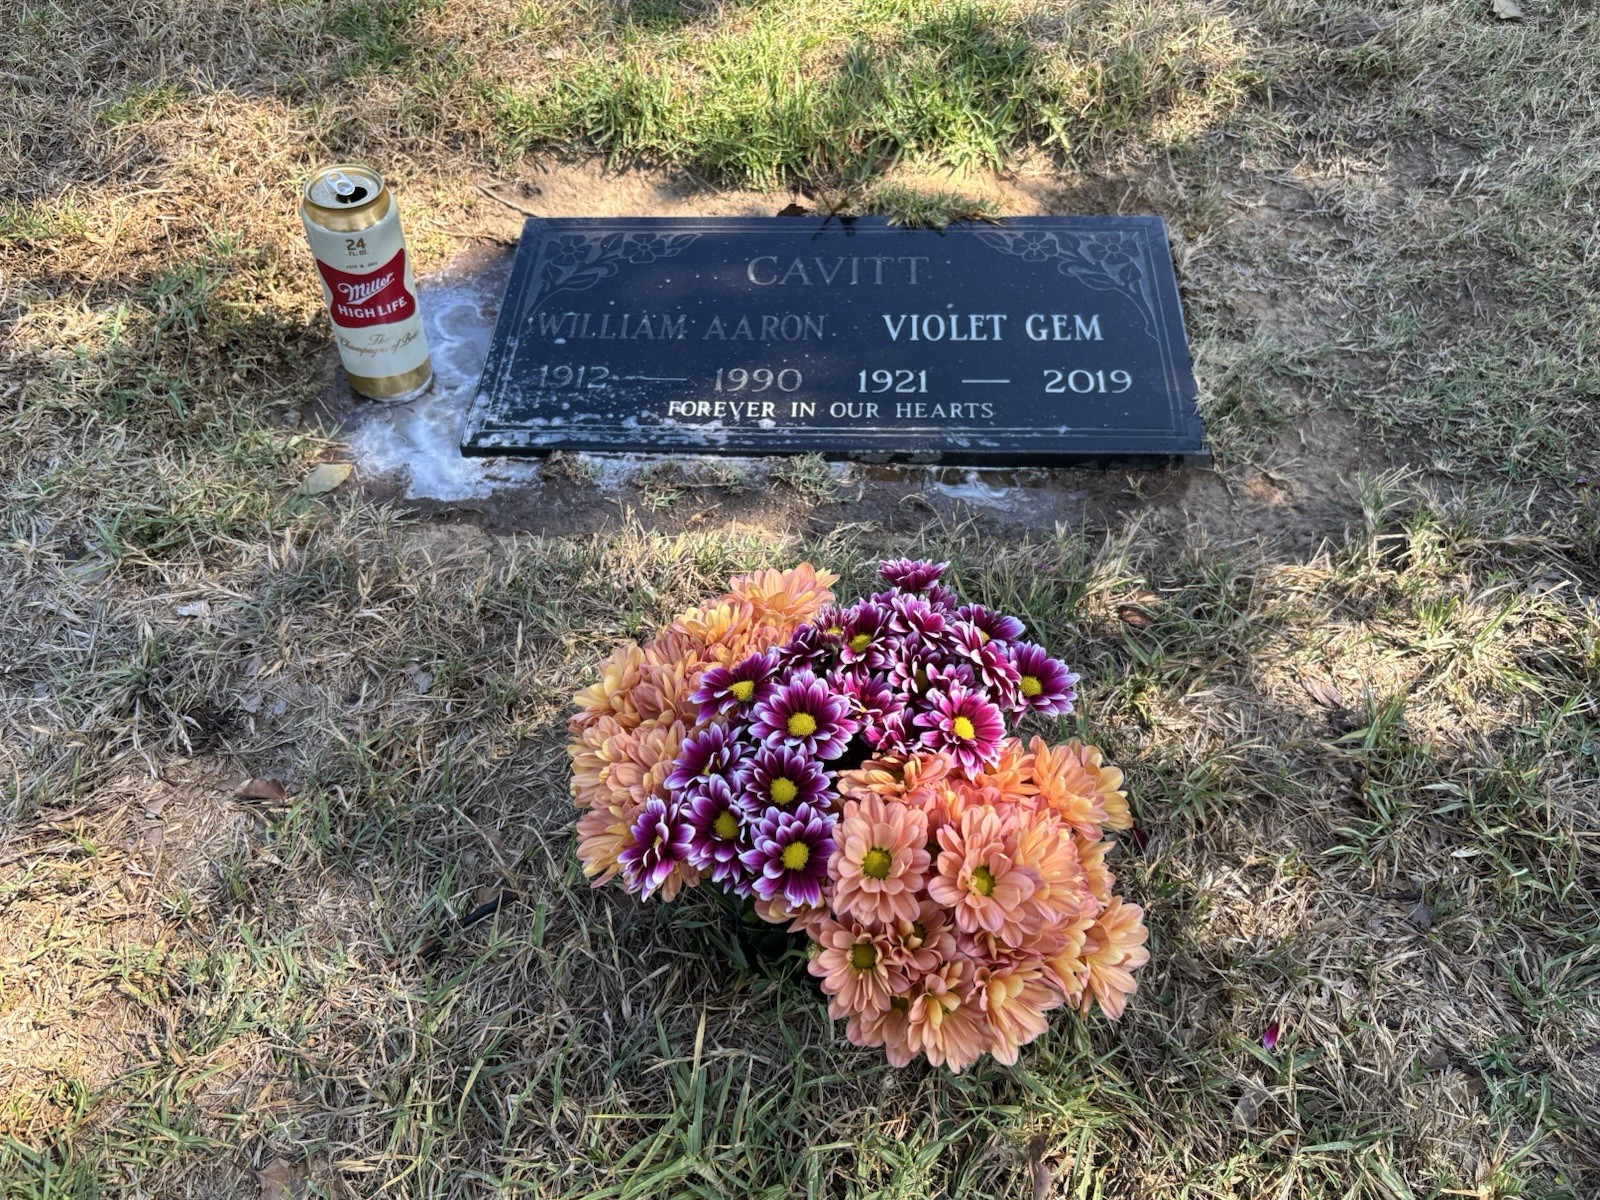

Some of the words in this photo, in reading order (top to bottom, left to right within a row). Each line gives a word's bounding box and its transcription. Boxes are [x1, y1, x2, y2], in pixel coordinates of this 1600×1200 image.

[345, 237, 366, 250] 24
[746, 255, 930, 286] CAVITT
[338, 272, 395, 305] Miller
[338, 304, 375, 318] HIGH
[377, 296, 407, 316] LIFE
[367, 334, 389, 345] The
[537, 313, 688, 340] WILLIAM
[702, 314, 826, 341] AARON
[881, 314, 1008, 342] VIOLET
[1025, 313, 1104, 342] GEM
[340, 337, 388, 357] Champagne
[391, 339, 401, 355] of
[539, 364, 610, 390] 1912
[714, 367, 803, 393] 1990
[857, 369, 929, 394] 1921
[1043, 369, 1133, 394] 2019
[667, 400, 776, 418] FOREVER
[790, 401, 817, 418] IN
[829, 401, 880, 419] OUR
[895, 402, 995, 419] HEARTS
